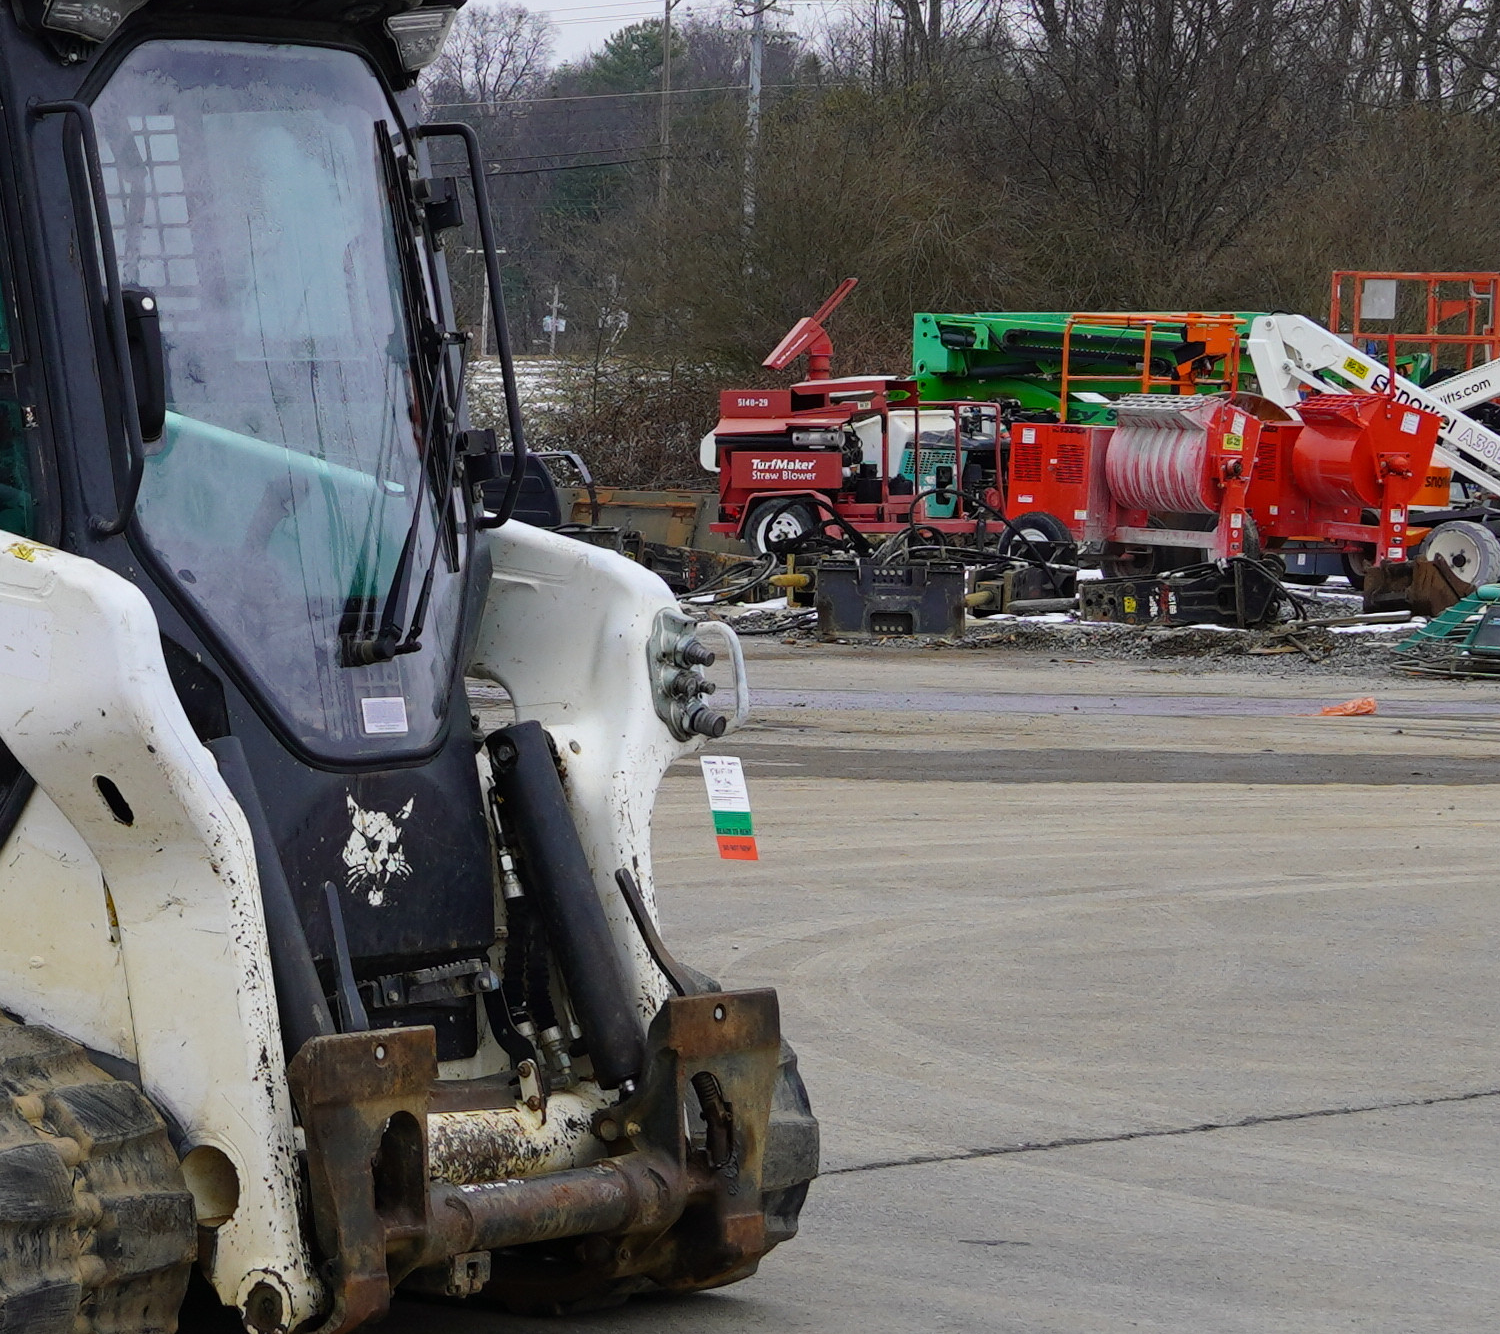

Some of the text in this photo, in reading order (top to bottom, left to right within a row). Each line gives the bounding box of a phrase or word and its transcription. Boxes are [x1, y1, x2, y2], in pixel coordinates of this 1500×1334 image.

[751, 459, 816, 470] TurfMaker
[752, 471, 816, 480] Straw Blower
